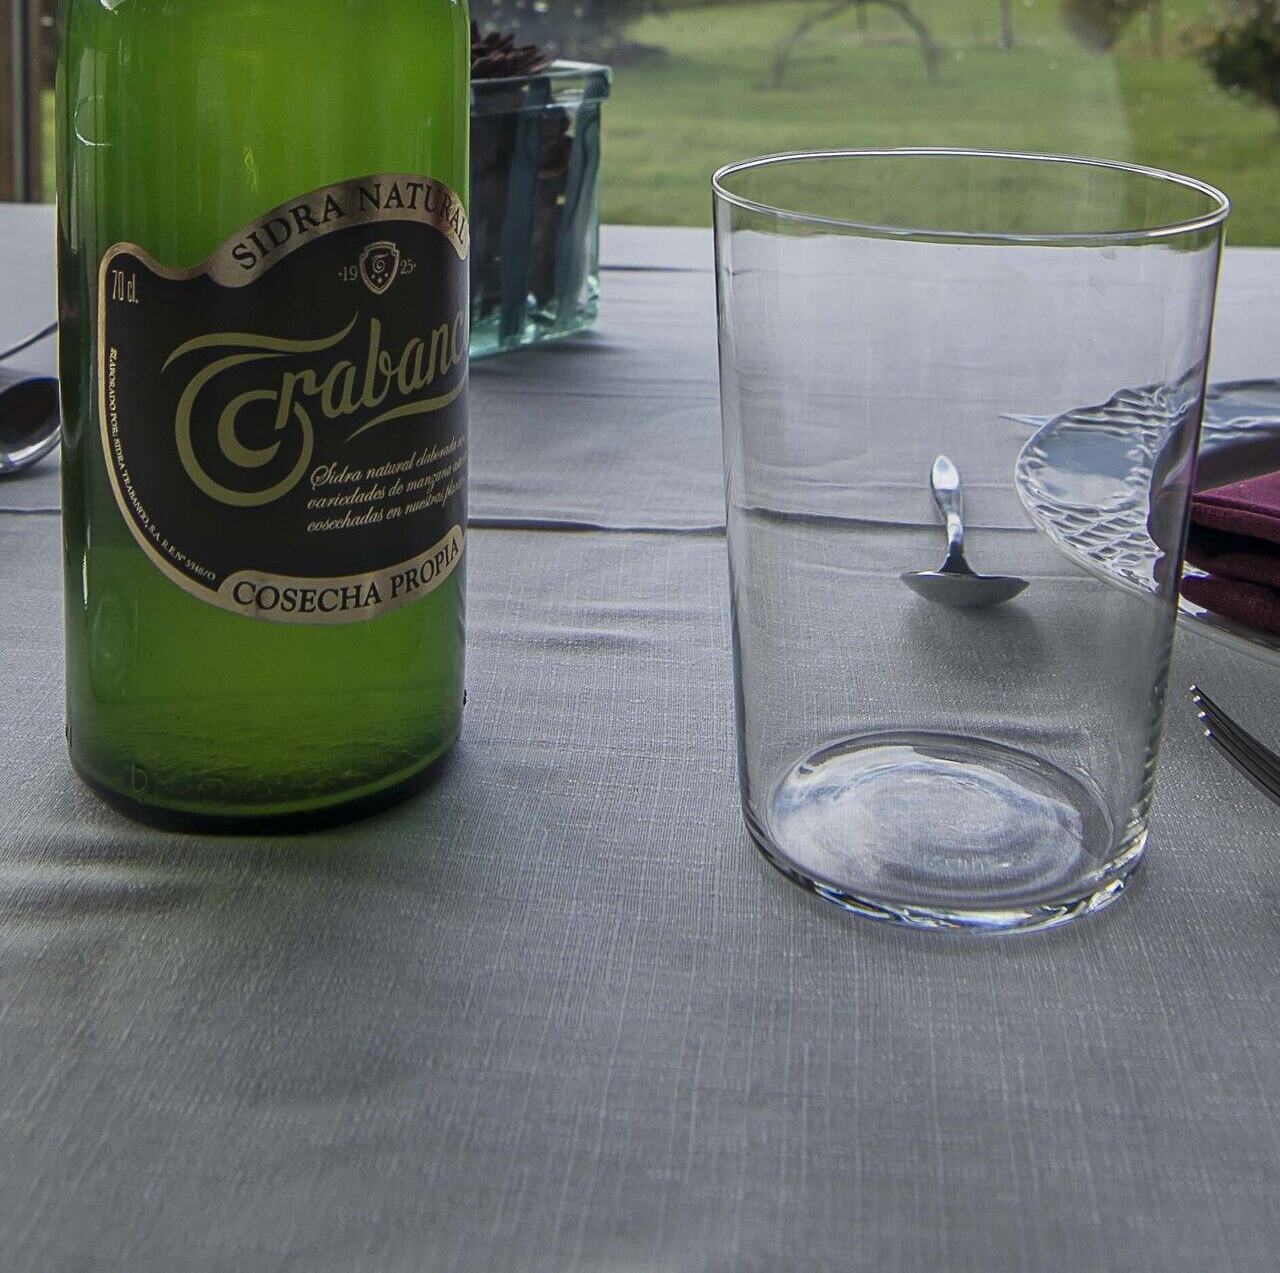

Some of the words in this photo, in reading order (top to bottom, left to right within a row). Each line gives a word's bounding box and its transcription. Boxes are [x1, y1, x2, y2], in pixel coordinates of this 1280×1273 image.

[232, 194, 346, 270] SIDRA
[358, 182, 466, 244] NATURAL
[112, 269, 124, 301] 70
[127, 273, 139, 304] cl.
[114, 438, 126, 470] SIDRA
[310, 461, 363, 490] Sidra
[366, 451, 418, 479] natural
[307, 483, 386, 510] variedades
[388, 478, 402, 497] de
[406, 464, 451, 495] manzana
[307, 506, 385, 533] cosechadas
[386, 507, 402, 520] en
[232, 581, 384, 613] COSECHA
[390, 537, 459, 599] PROPIA
